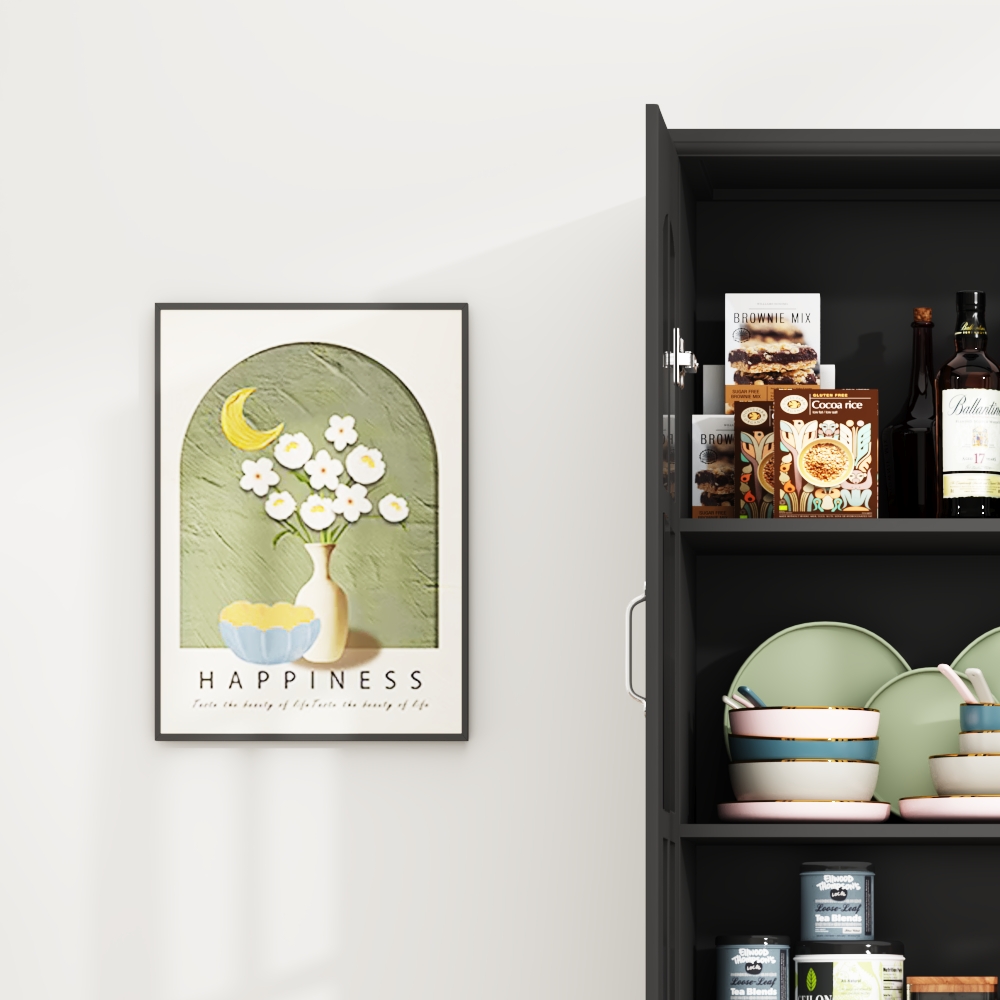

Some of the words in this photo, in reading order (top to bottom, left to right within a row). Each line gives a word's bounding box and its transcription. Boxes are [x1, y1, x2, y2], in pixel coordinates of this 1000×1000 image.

[733, 312, 785, 324] BROWNIE
[791, 312, 811, 324] MIX
[811, 399, 843, 410] Cocoa
[844, 399, 864, 410] rice
[974, 453, 985, 464] 17
[199, 670, 423, 690] HAPPINESS
[278, 700, 290, 711] of
[398, 700, 409, 711] of
[815, 903, 862, 914] Loose-Leaf
[815, 913, 830, 922] Tea
[831, 913, 862, 922] Blends
[730, 976, 777, 987] Loose-Leaf
[730, 987, 745, 996] Tea
[746, 987, 777, 996] Blends
